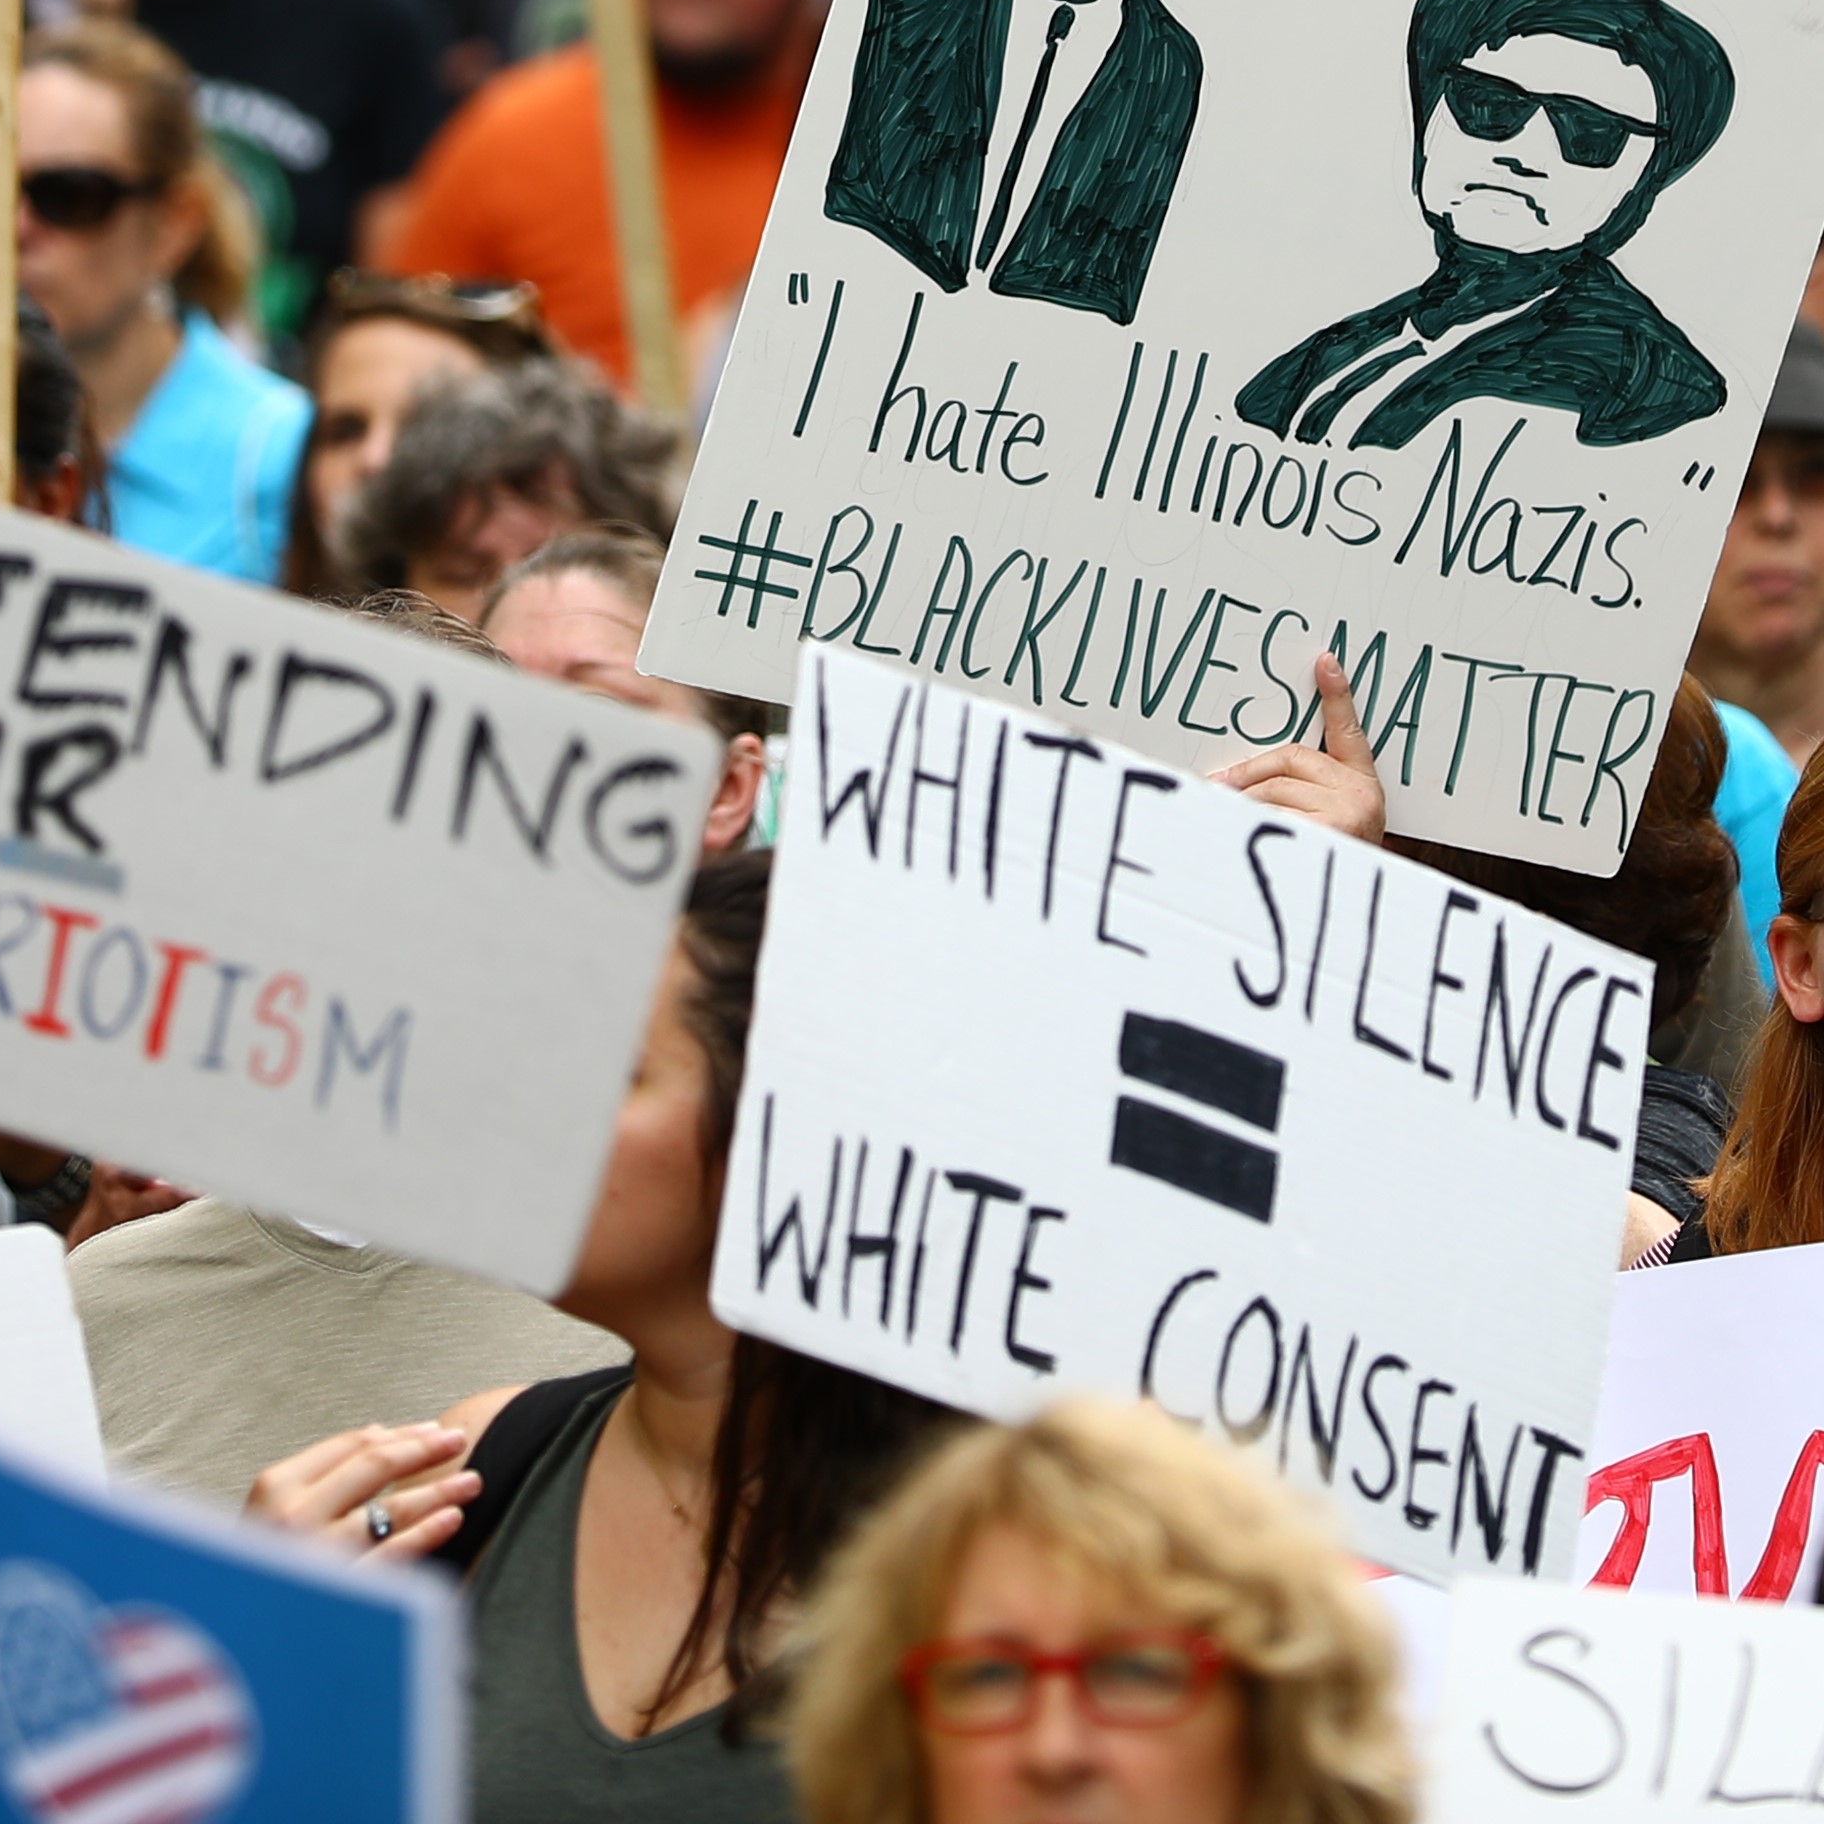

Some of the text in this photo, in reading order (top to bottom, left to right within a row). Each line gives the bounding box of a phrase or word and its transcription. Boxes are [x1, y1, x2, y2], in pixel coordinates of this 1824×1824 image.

[869, 291, 1050, 487] hate
[1095, 341, 1382, 547] Illinois
[694, 498, 1657, 855] #BLACKLIVESMATTER
[815, 655, 1644, 1151] WHITE SILENCE
[756, 1092, 1068, 1375] WHITE
[1140, 1269, 1585, 1579] CONSENT
